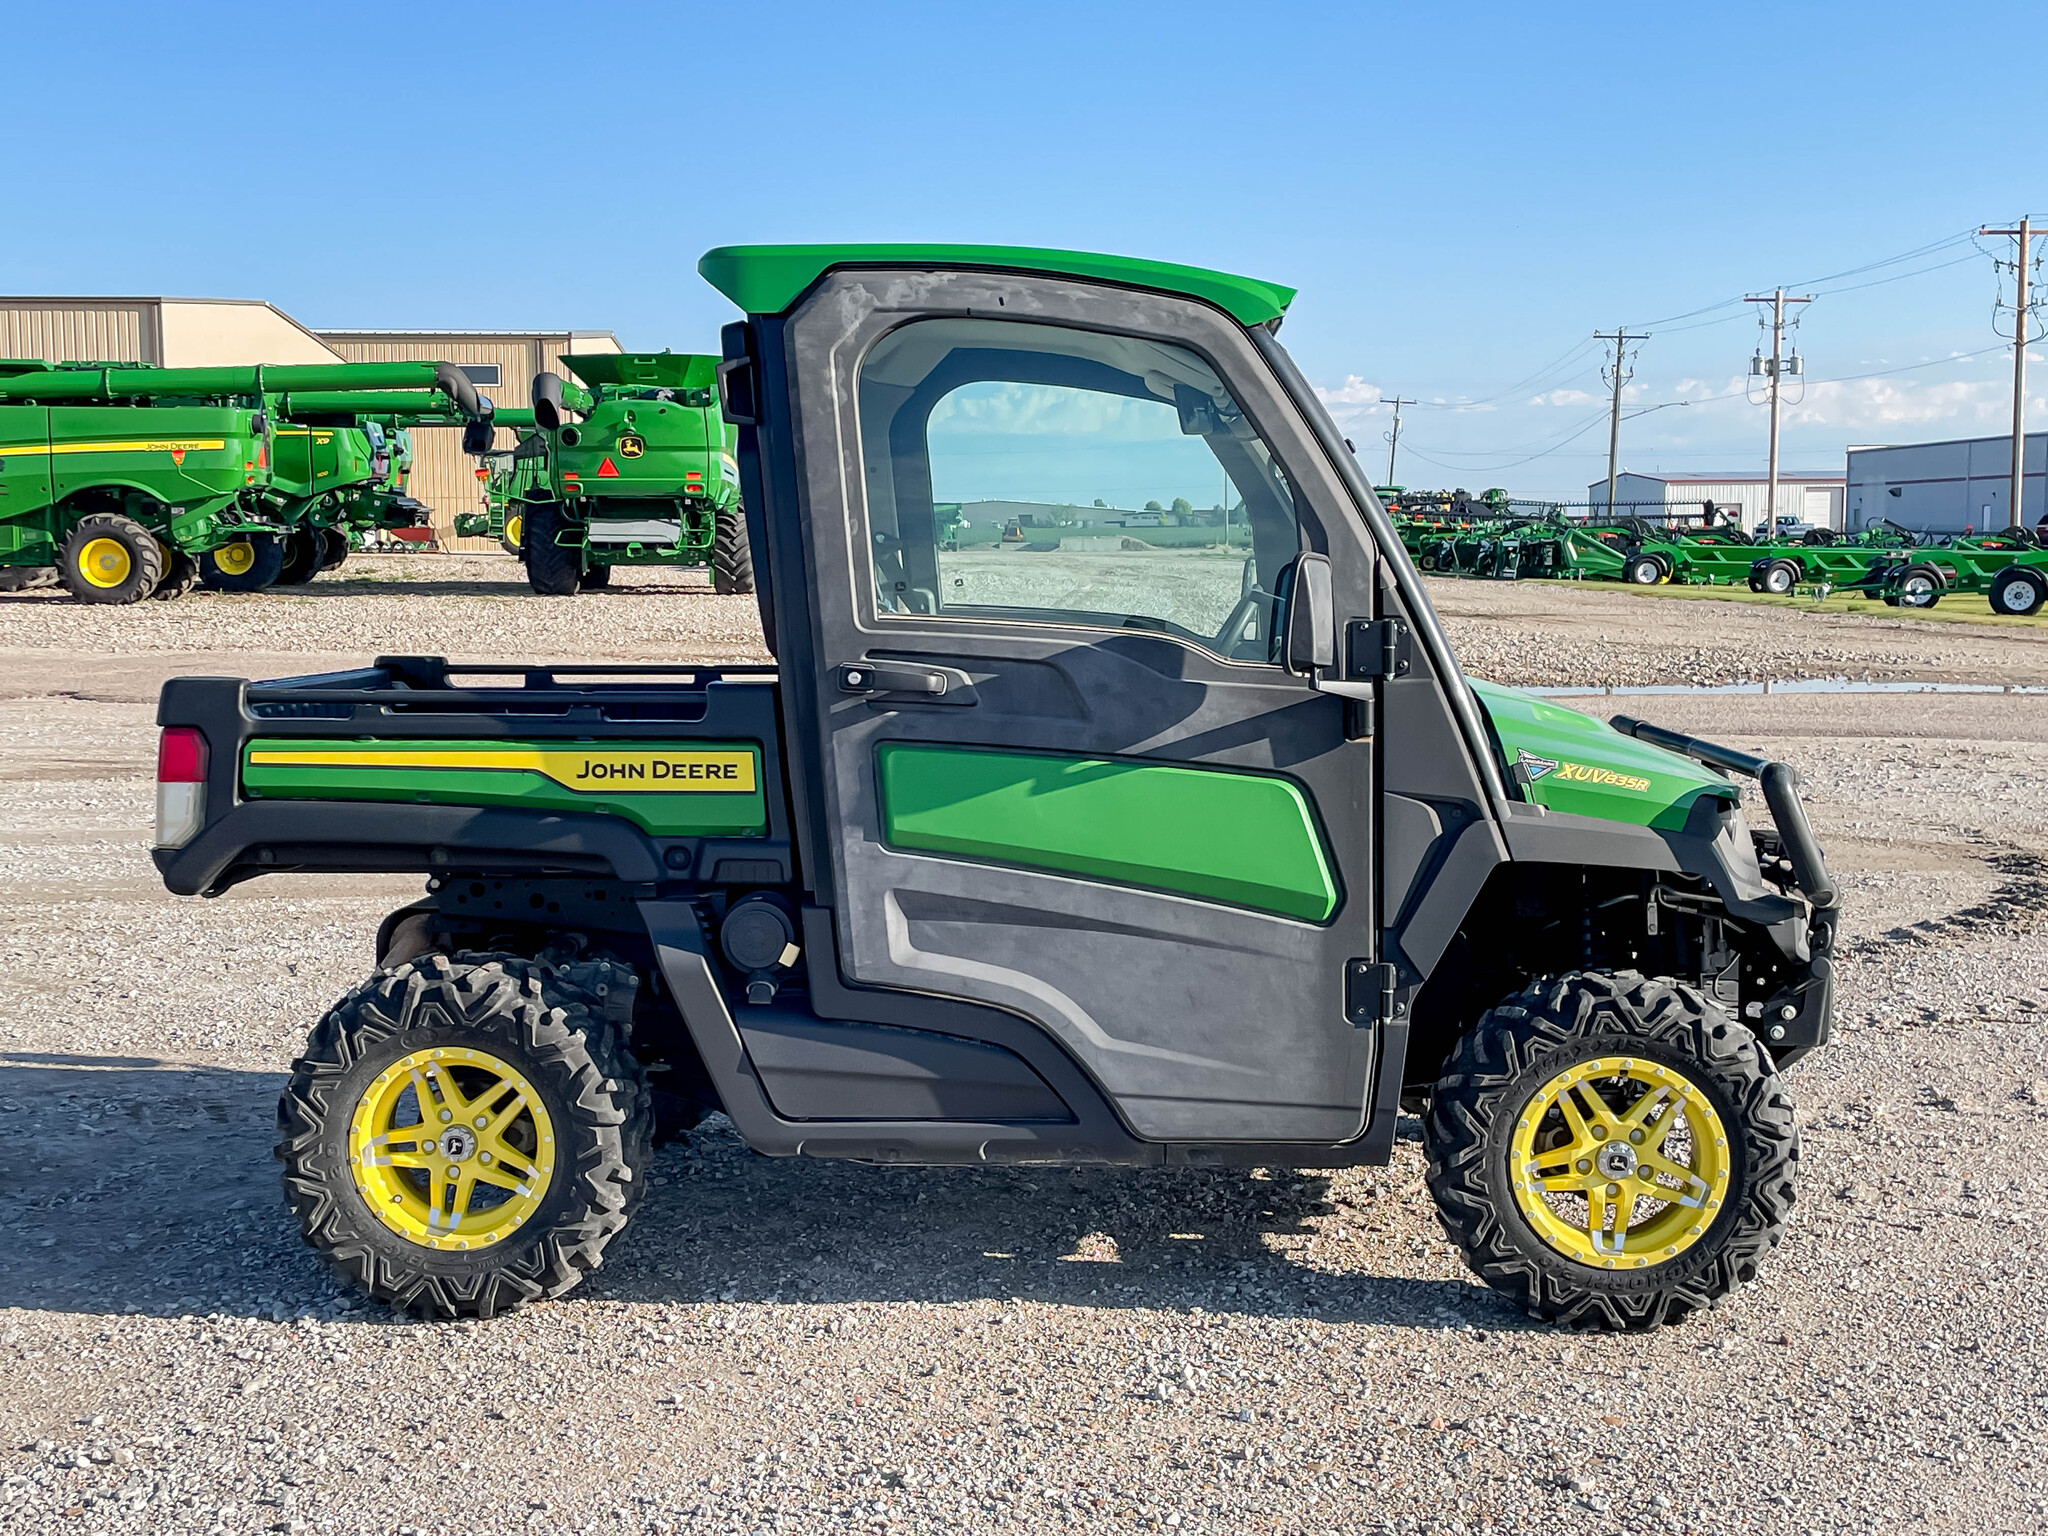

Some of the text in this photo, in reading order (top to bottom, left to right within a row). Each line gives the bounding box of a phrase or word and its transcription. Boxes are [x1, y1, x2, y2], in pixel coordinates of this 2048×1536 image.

[170, 442, 200, 450] DEERE
[576, 760, 738, 779] JOHN DEERE
[1555, 762, 1650, 792] XUV835R
